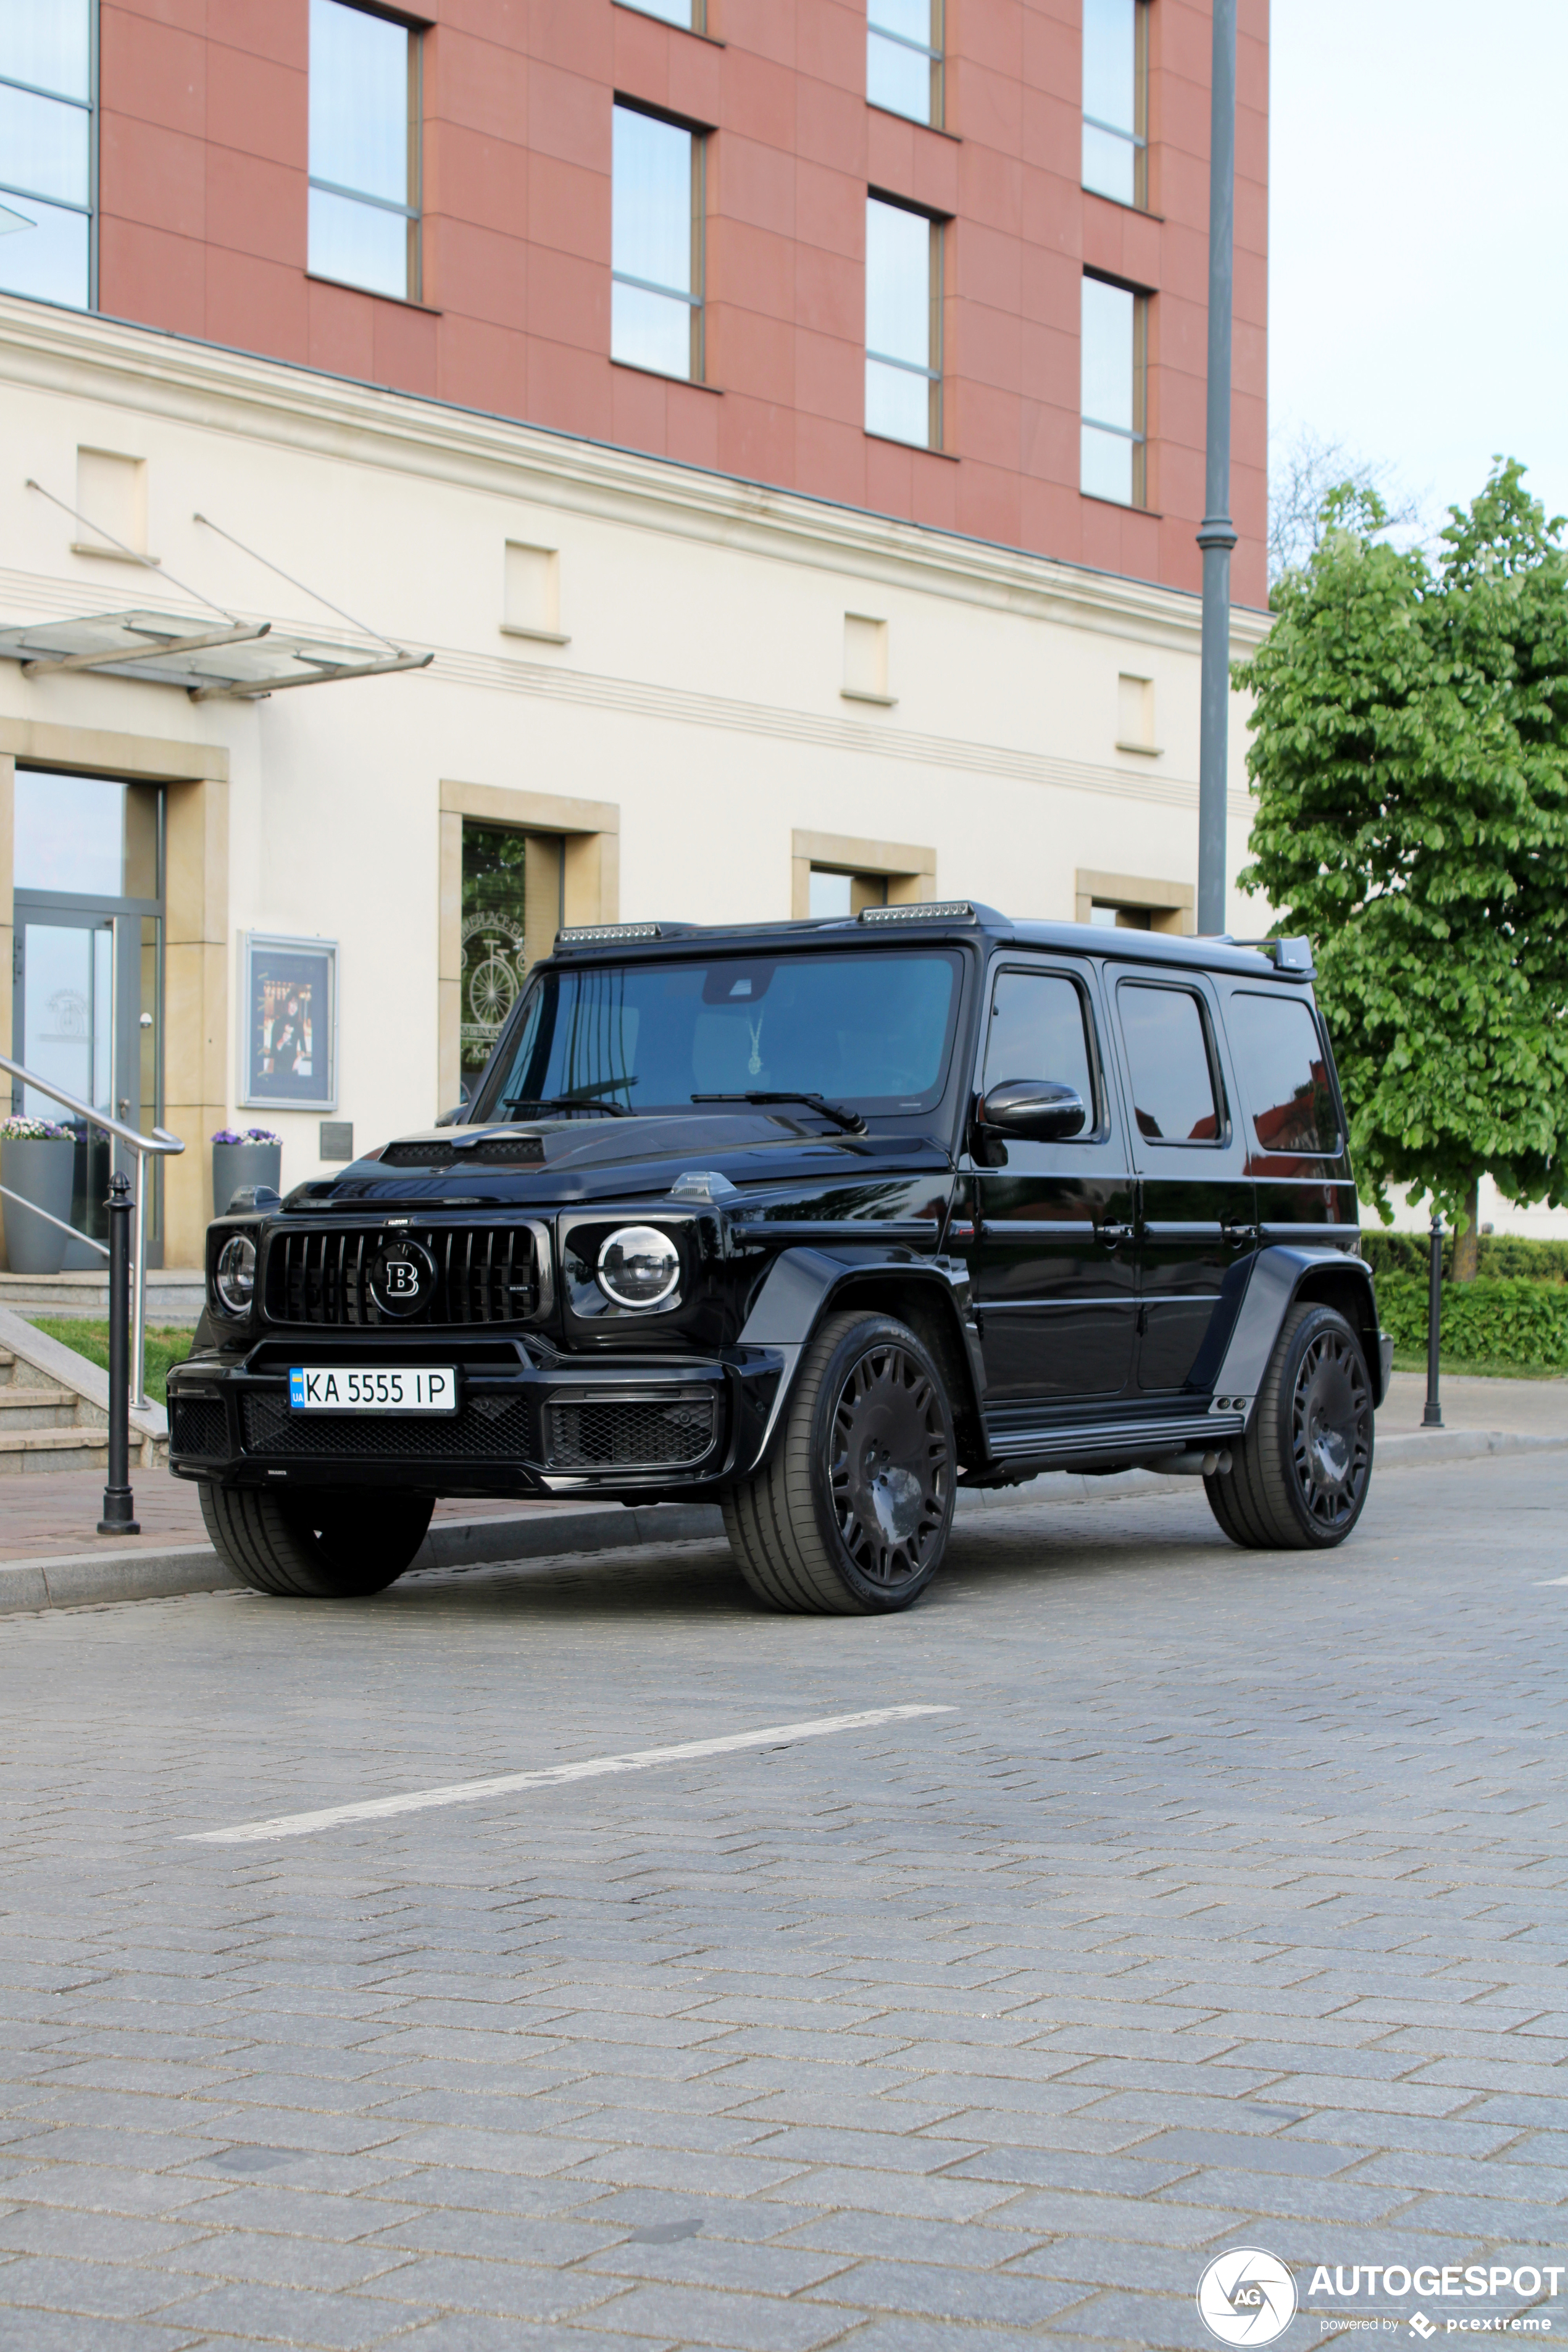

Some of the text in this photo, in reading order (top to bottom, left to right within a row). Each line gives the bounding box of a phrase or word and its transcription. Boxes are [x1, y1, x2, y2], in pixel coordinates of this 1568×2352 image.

[472, 1044, 494, 1059] Kra
[386, 1262, 419, 1296] B
[292, 1393, 304, 1403] UA
[306, 1374, 340, 1402] KA
[348, 1374, 404, 1403] 5555
